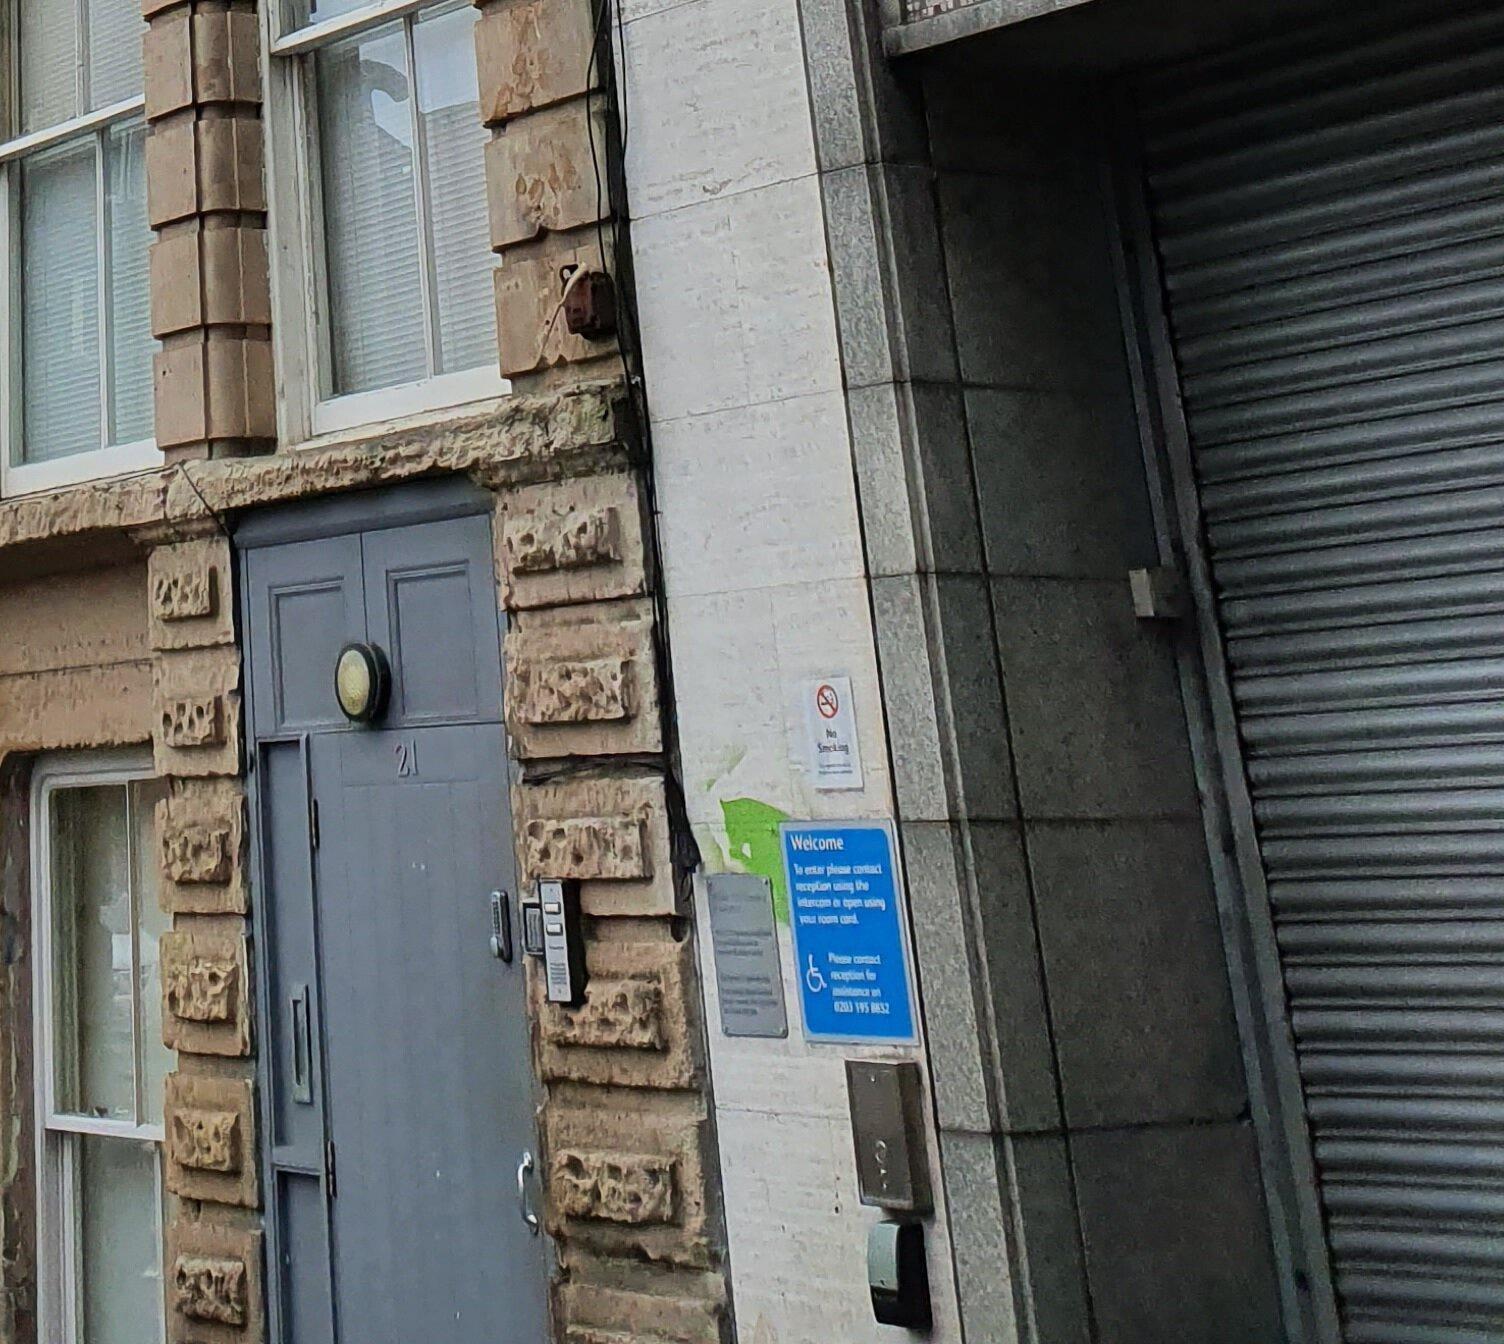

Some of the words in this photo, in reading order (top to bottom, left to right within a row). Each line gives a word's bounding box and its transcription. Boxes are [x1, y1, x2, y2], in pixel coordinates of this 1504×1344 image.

[825, 727, 837, 738] No
[395, 739, 419, 778] 21
[791, 834, 844, 850] Welcome
